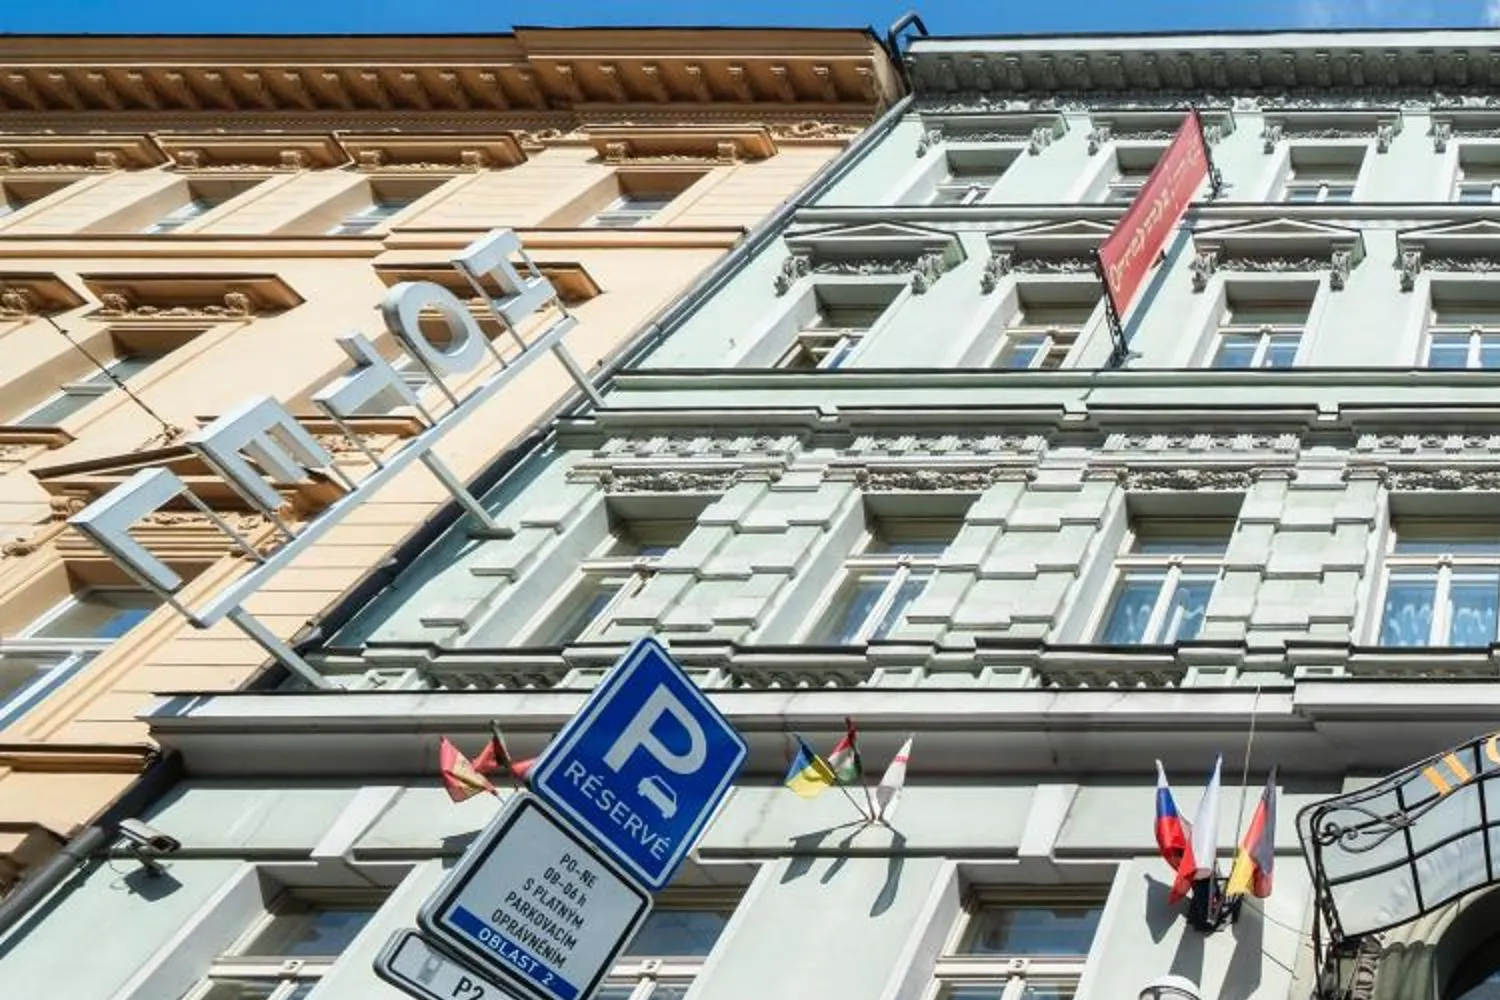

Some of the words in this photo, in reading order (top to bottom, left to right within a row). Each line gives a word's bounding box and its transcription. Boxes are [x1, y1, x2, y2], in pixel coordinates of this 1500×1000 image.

[68, 228, 558, 592] HOTEL
[602, 682, 707, 774] P
[563, 759, 672, 861] RÉSERVÉ
[522, 877, 535, 892] S
[560, 853, 599, 889] PO-NE
[503, 891, 578, 951] PARKOVACÍM
[478, 927, 539, 974] OBLAST
[541, 973, 554, 986] 2
